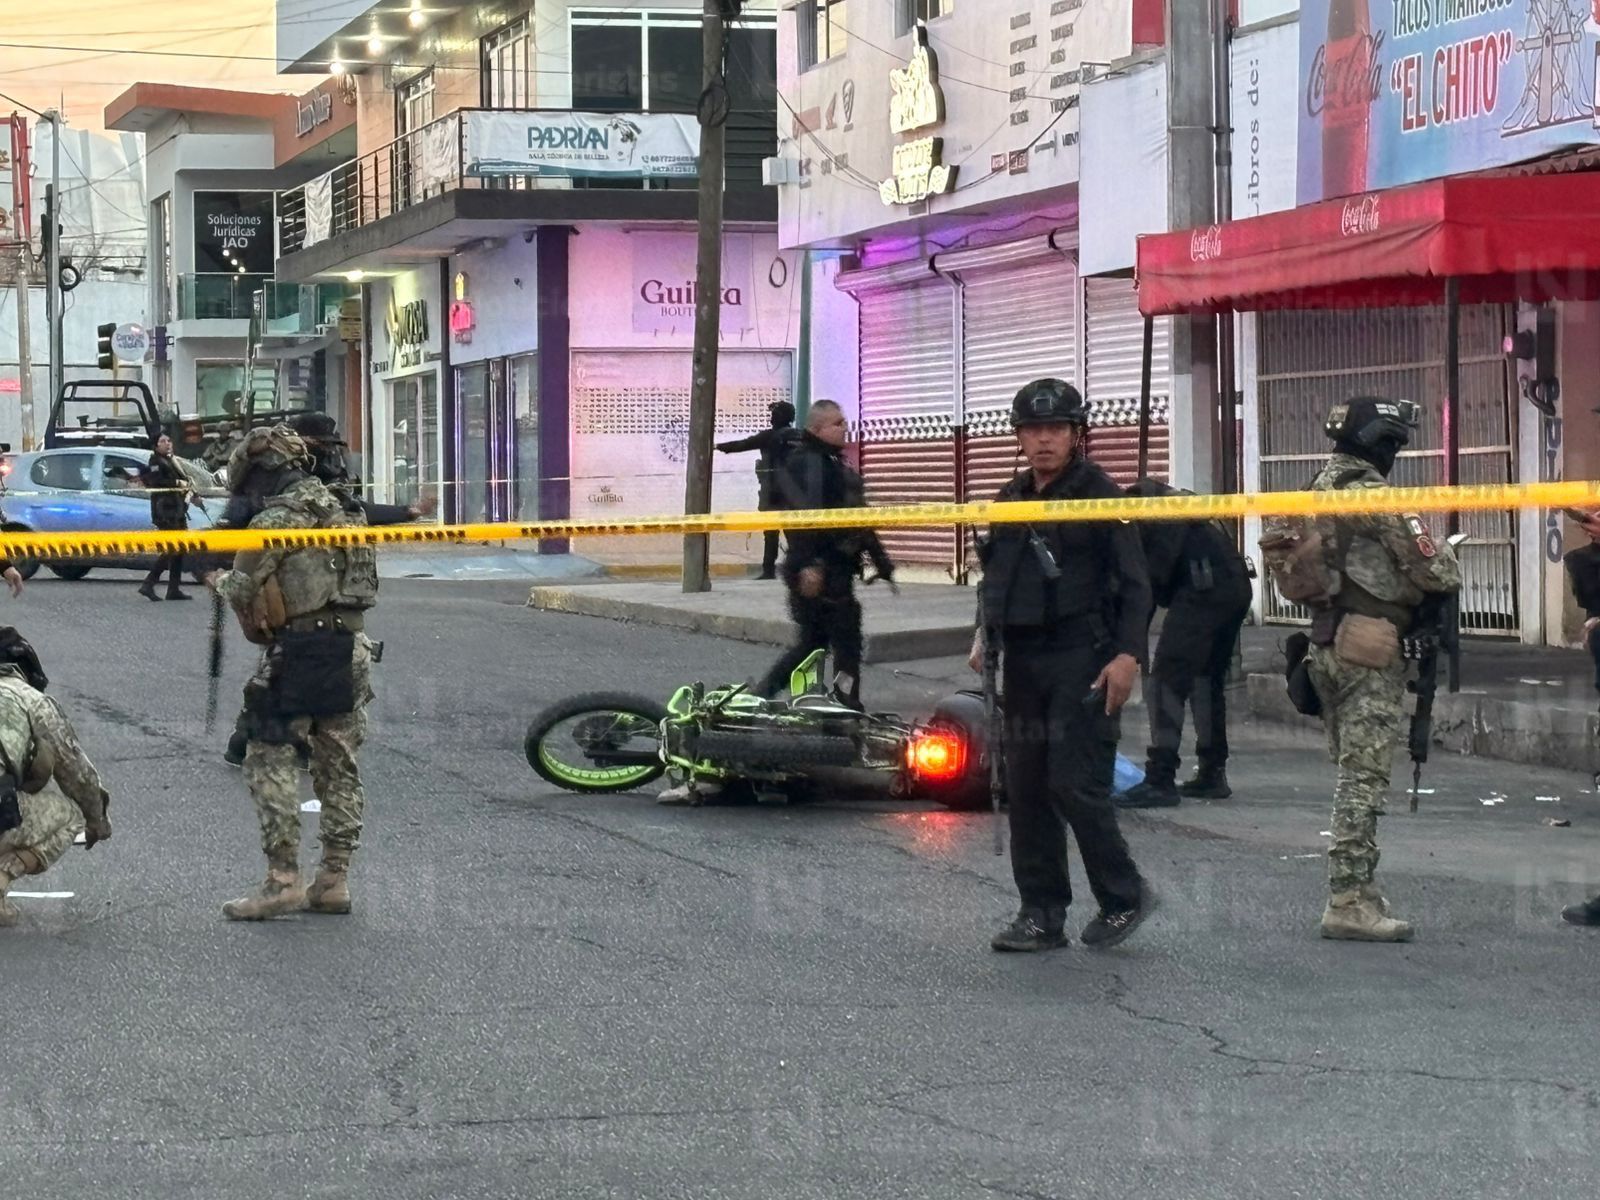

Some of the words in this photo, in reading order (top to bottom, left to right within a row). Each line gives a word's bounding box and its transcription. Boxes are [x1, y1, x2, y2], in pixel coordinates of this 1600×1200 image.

[1247, 58, 1260, 107] de:
[527, 126, 609, 150] PADRIAN
[207, 213, 262, 225] Soluciones
[1340, 194, 1380, 237] Coca-Cola
[212, 225, 257, 237] Jurídicas
[221, 237, 249, 248] JAO
[1190, 224, 1222, 262] Coca-Cola
[640, 279, 742, 306] Guila
[660, 306, 695, 317] BOUT
